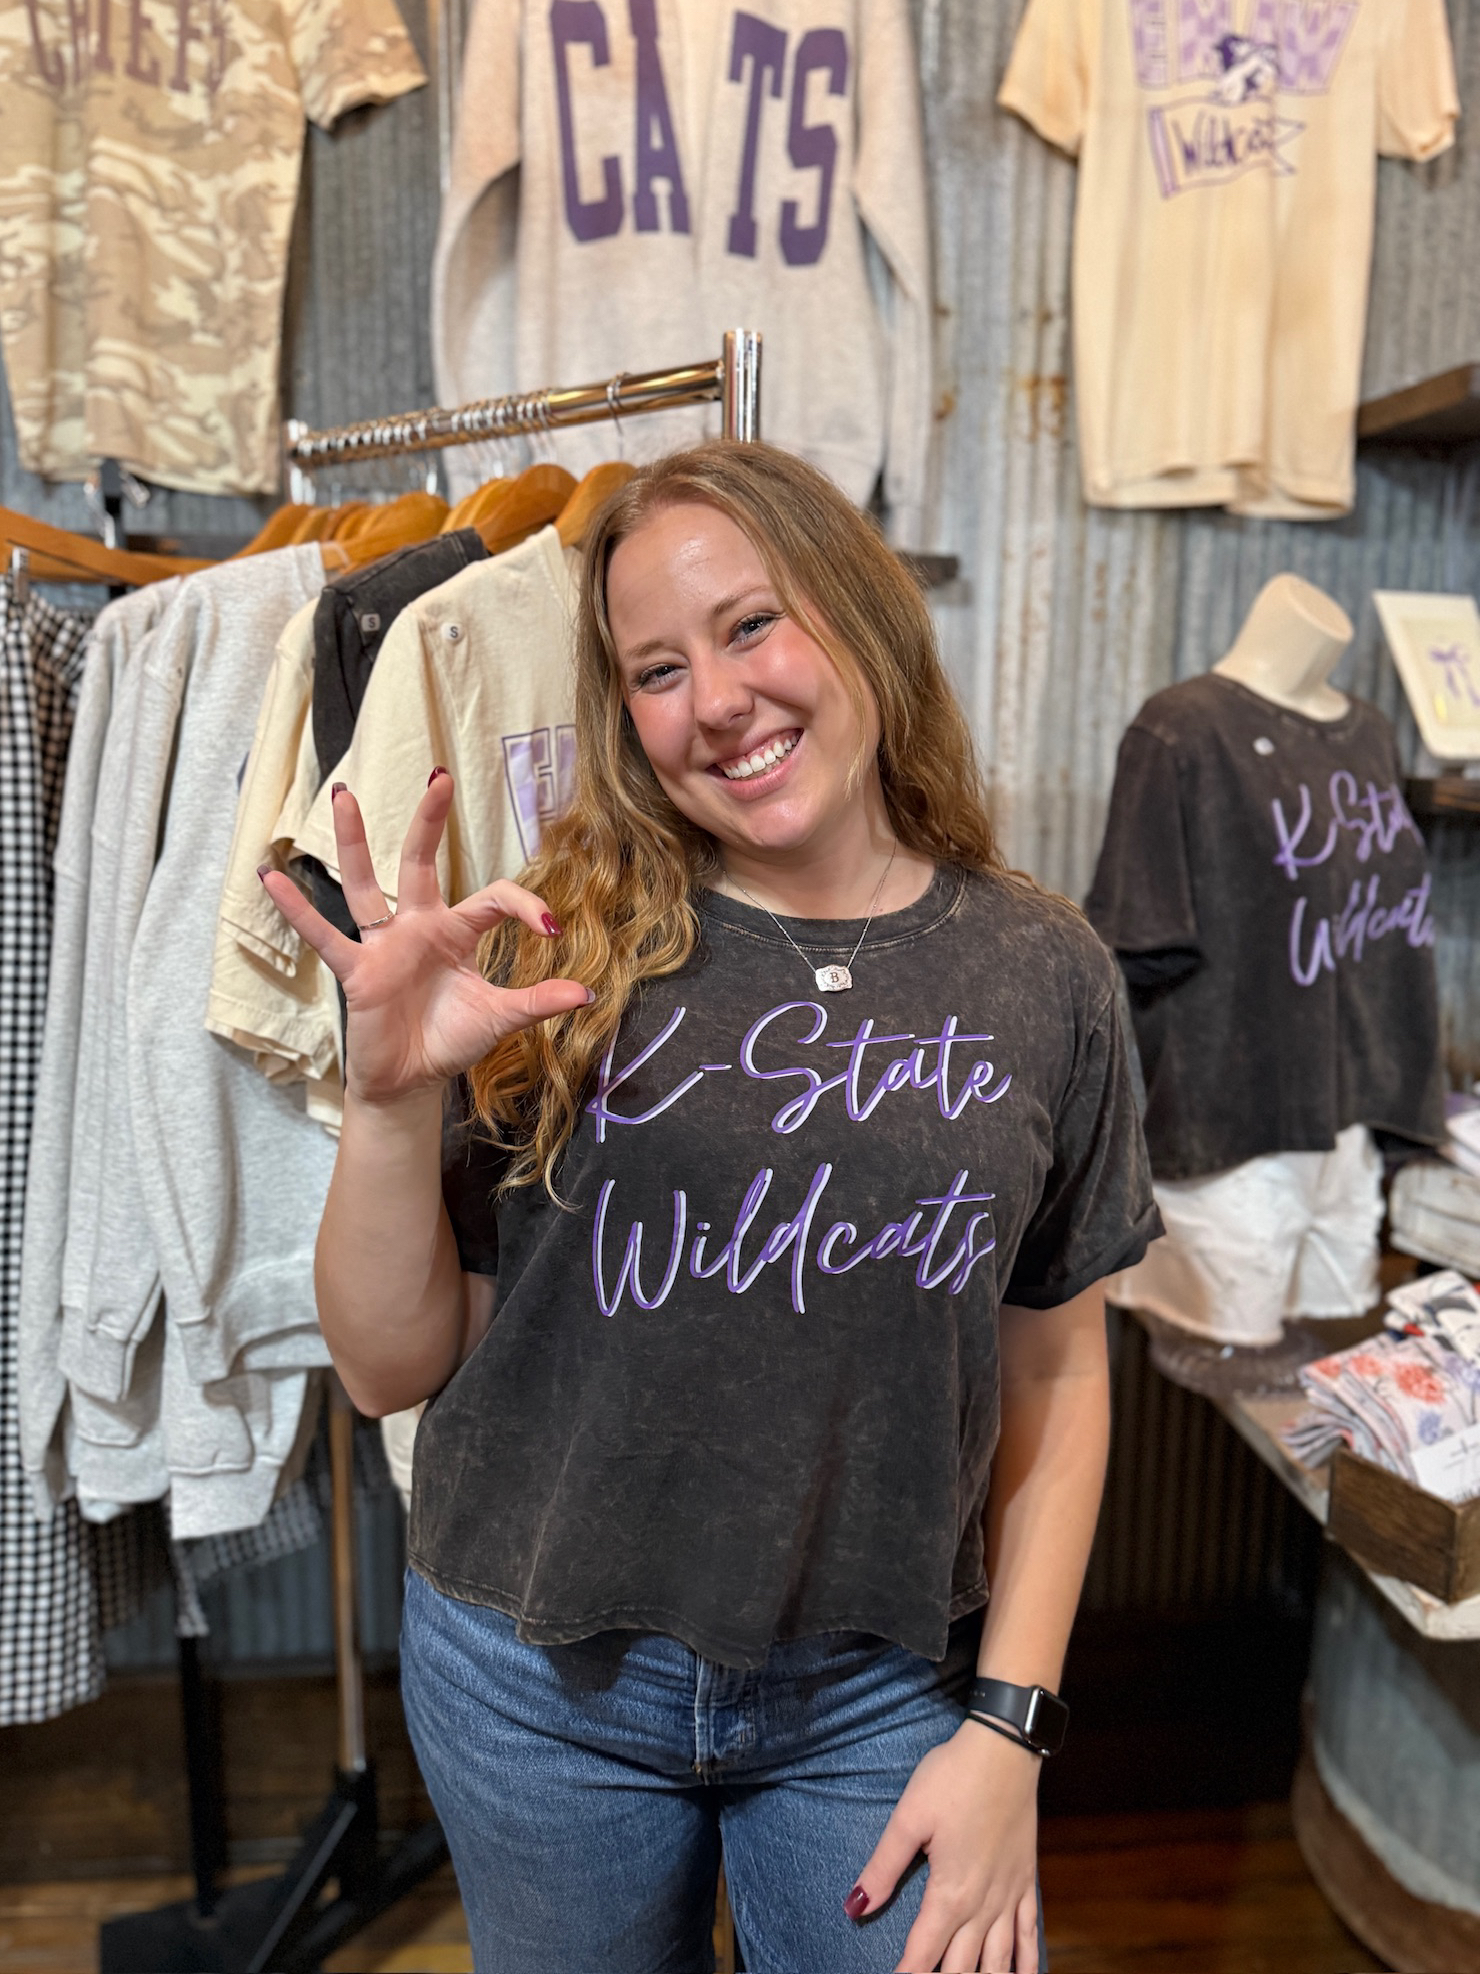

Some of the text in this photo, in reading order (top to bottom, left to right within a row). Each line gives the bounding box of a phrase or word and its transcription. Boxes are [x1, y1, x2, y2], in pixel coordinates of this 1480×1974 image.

[550, 0, 849, 268] CATS
[450, 626, 459, 639] S
[585, 1001, 1013, 1143] K-State
[592, 1163, 996, 1318] Wildcats
